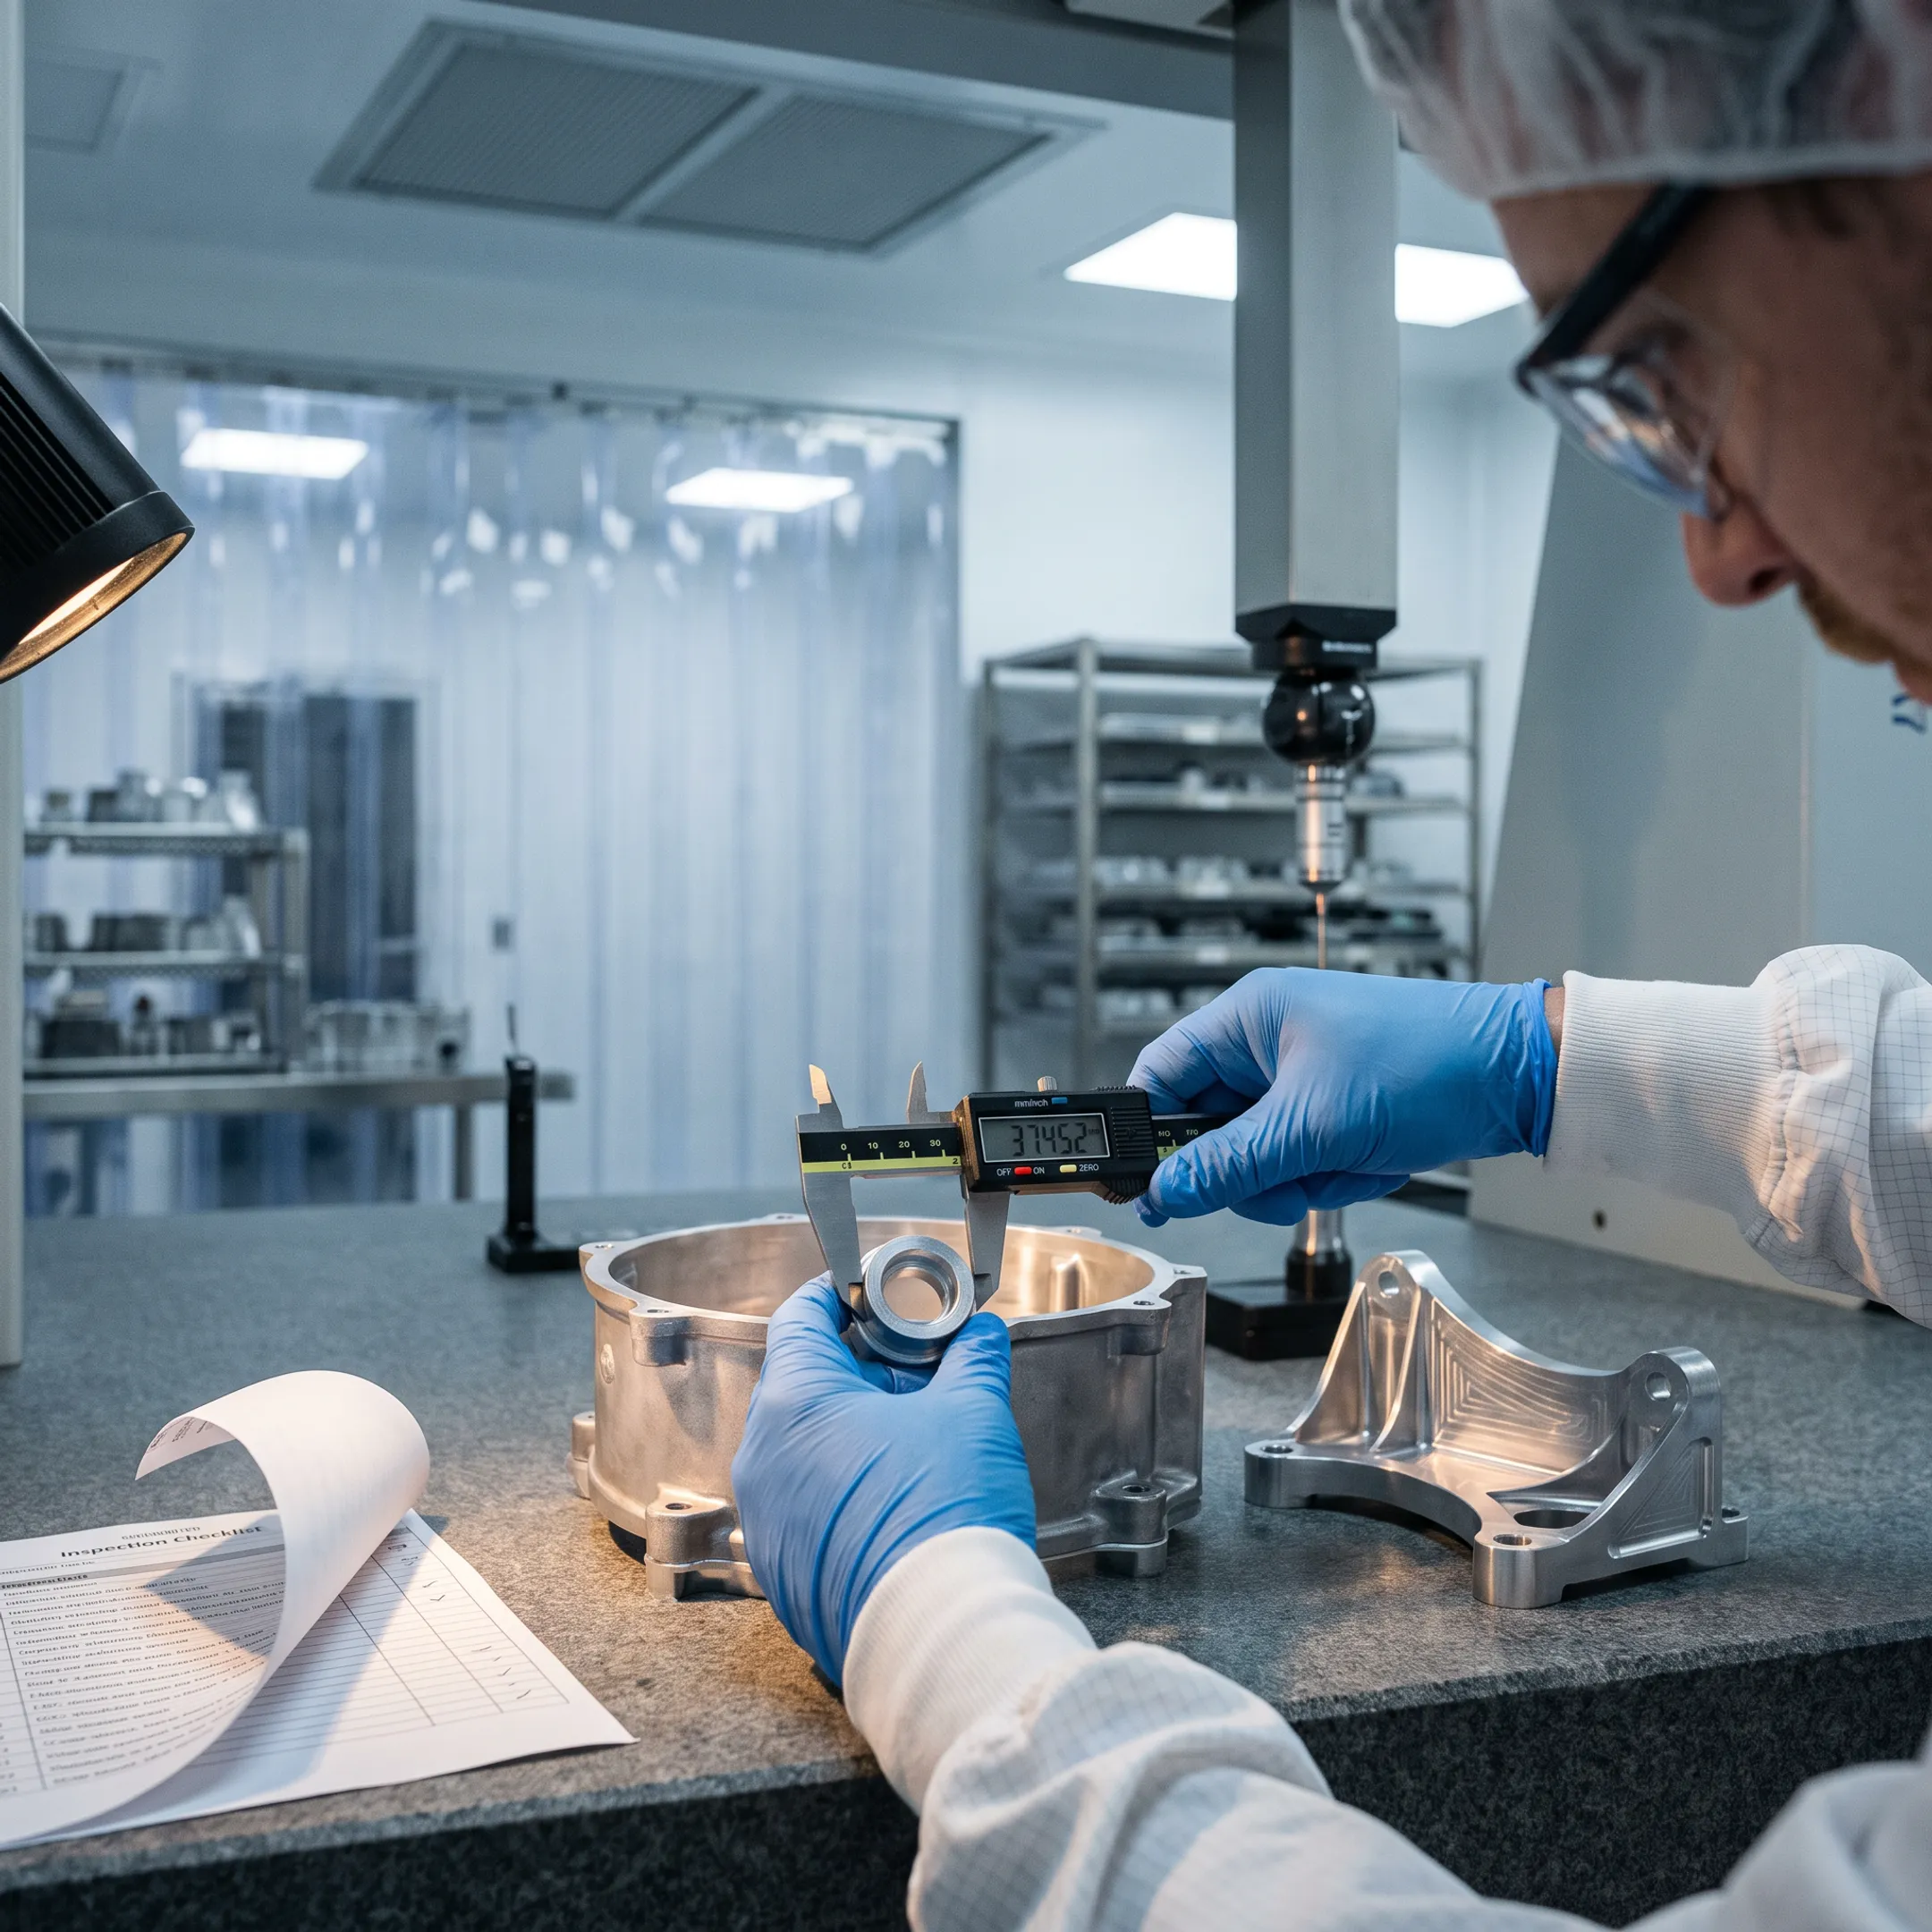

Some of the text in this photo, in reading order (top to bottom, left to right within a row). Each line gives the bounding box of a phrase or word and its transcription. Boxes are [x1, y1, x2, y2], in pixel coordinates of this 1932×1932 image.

[898, 1140, 910, 1148] 20
[1032, 1166, 1045, 1174] ON
[61, 1538, 167, 1558] Inspection
